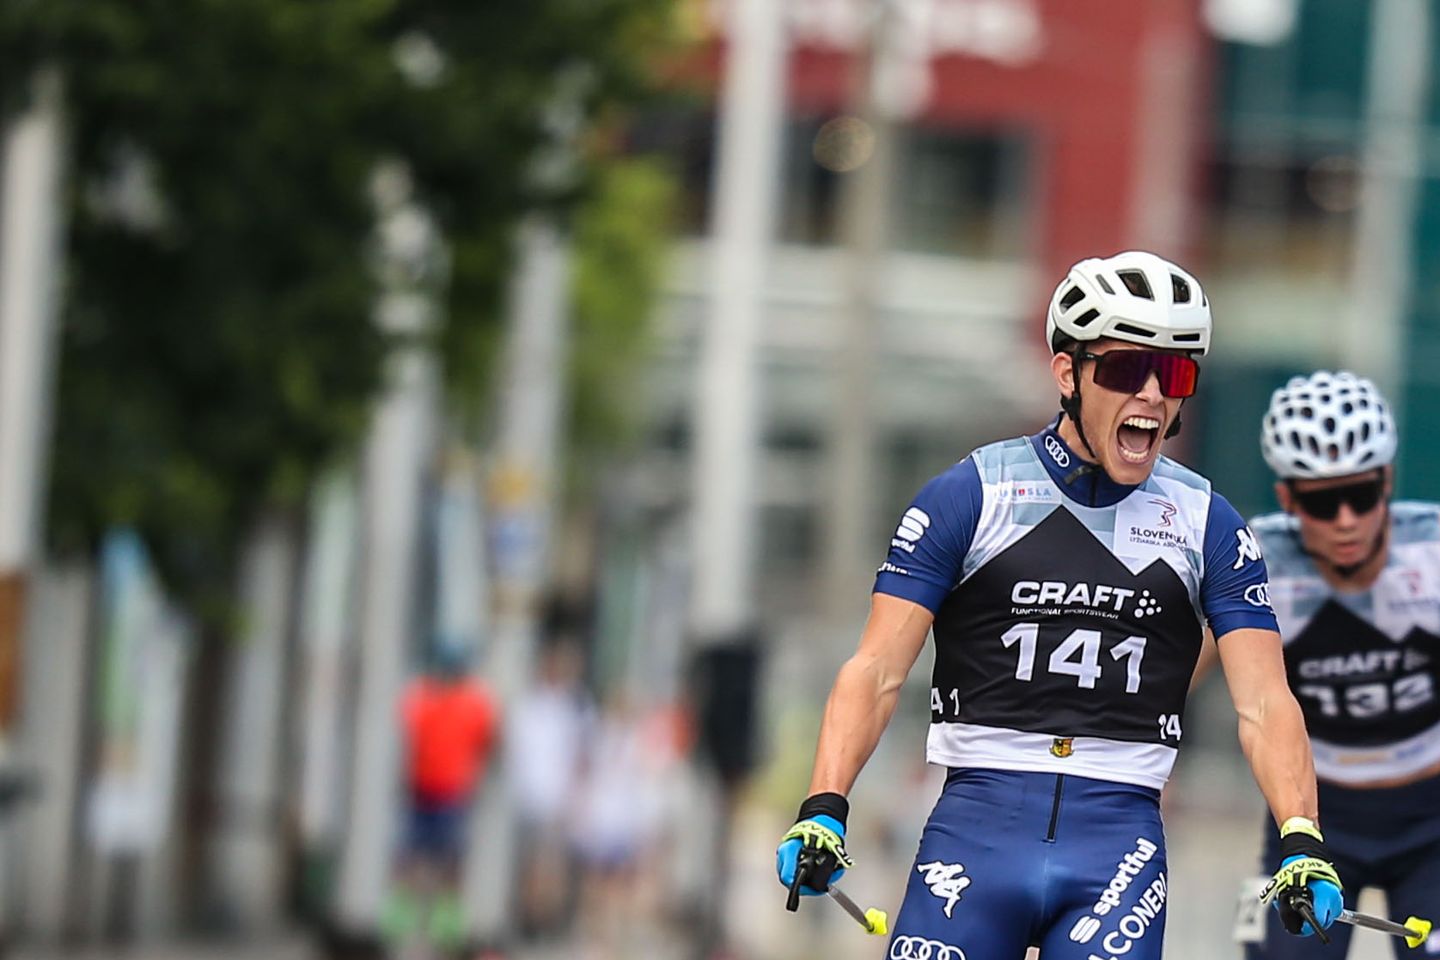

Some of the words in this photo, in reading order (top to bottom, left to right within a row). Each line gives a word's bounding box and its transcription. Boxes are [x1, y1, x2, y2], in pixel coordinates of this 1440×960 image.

[1011, 581, 1135, 611] CRAFT
[1011, 607, 1061, 616] FUNCTIONAL
[1001, 622, 1147, 694] 141
[1299, 650, 1401, 678] CRAFT
[1093, 838, 1158, 916] sportful
